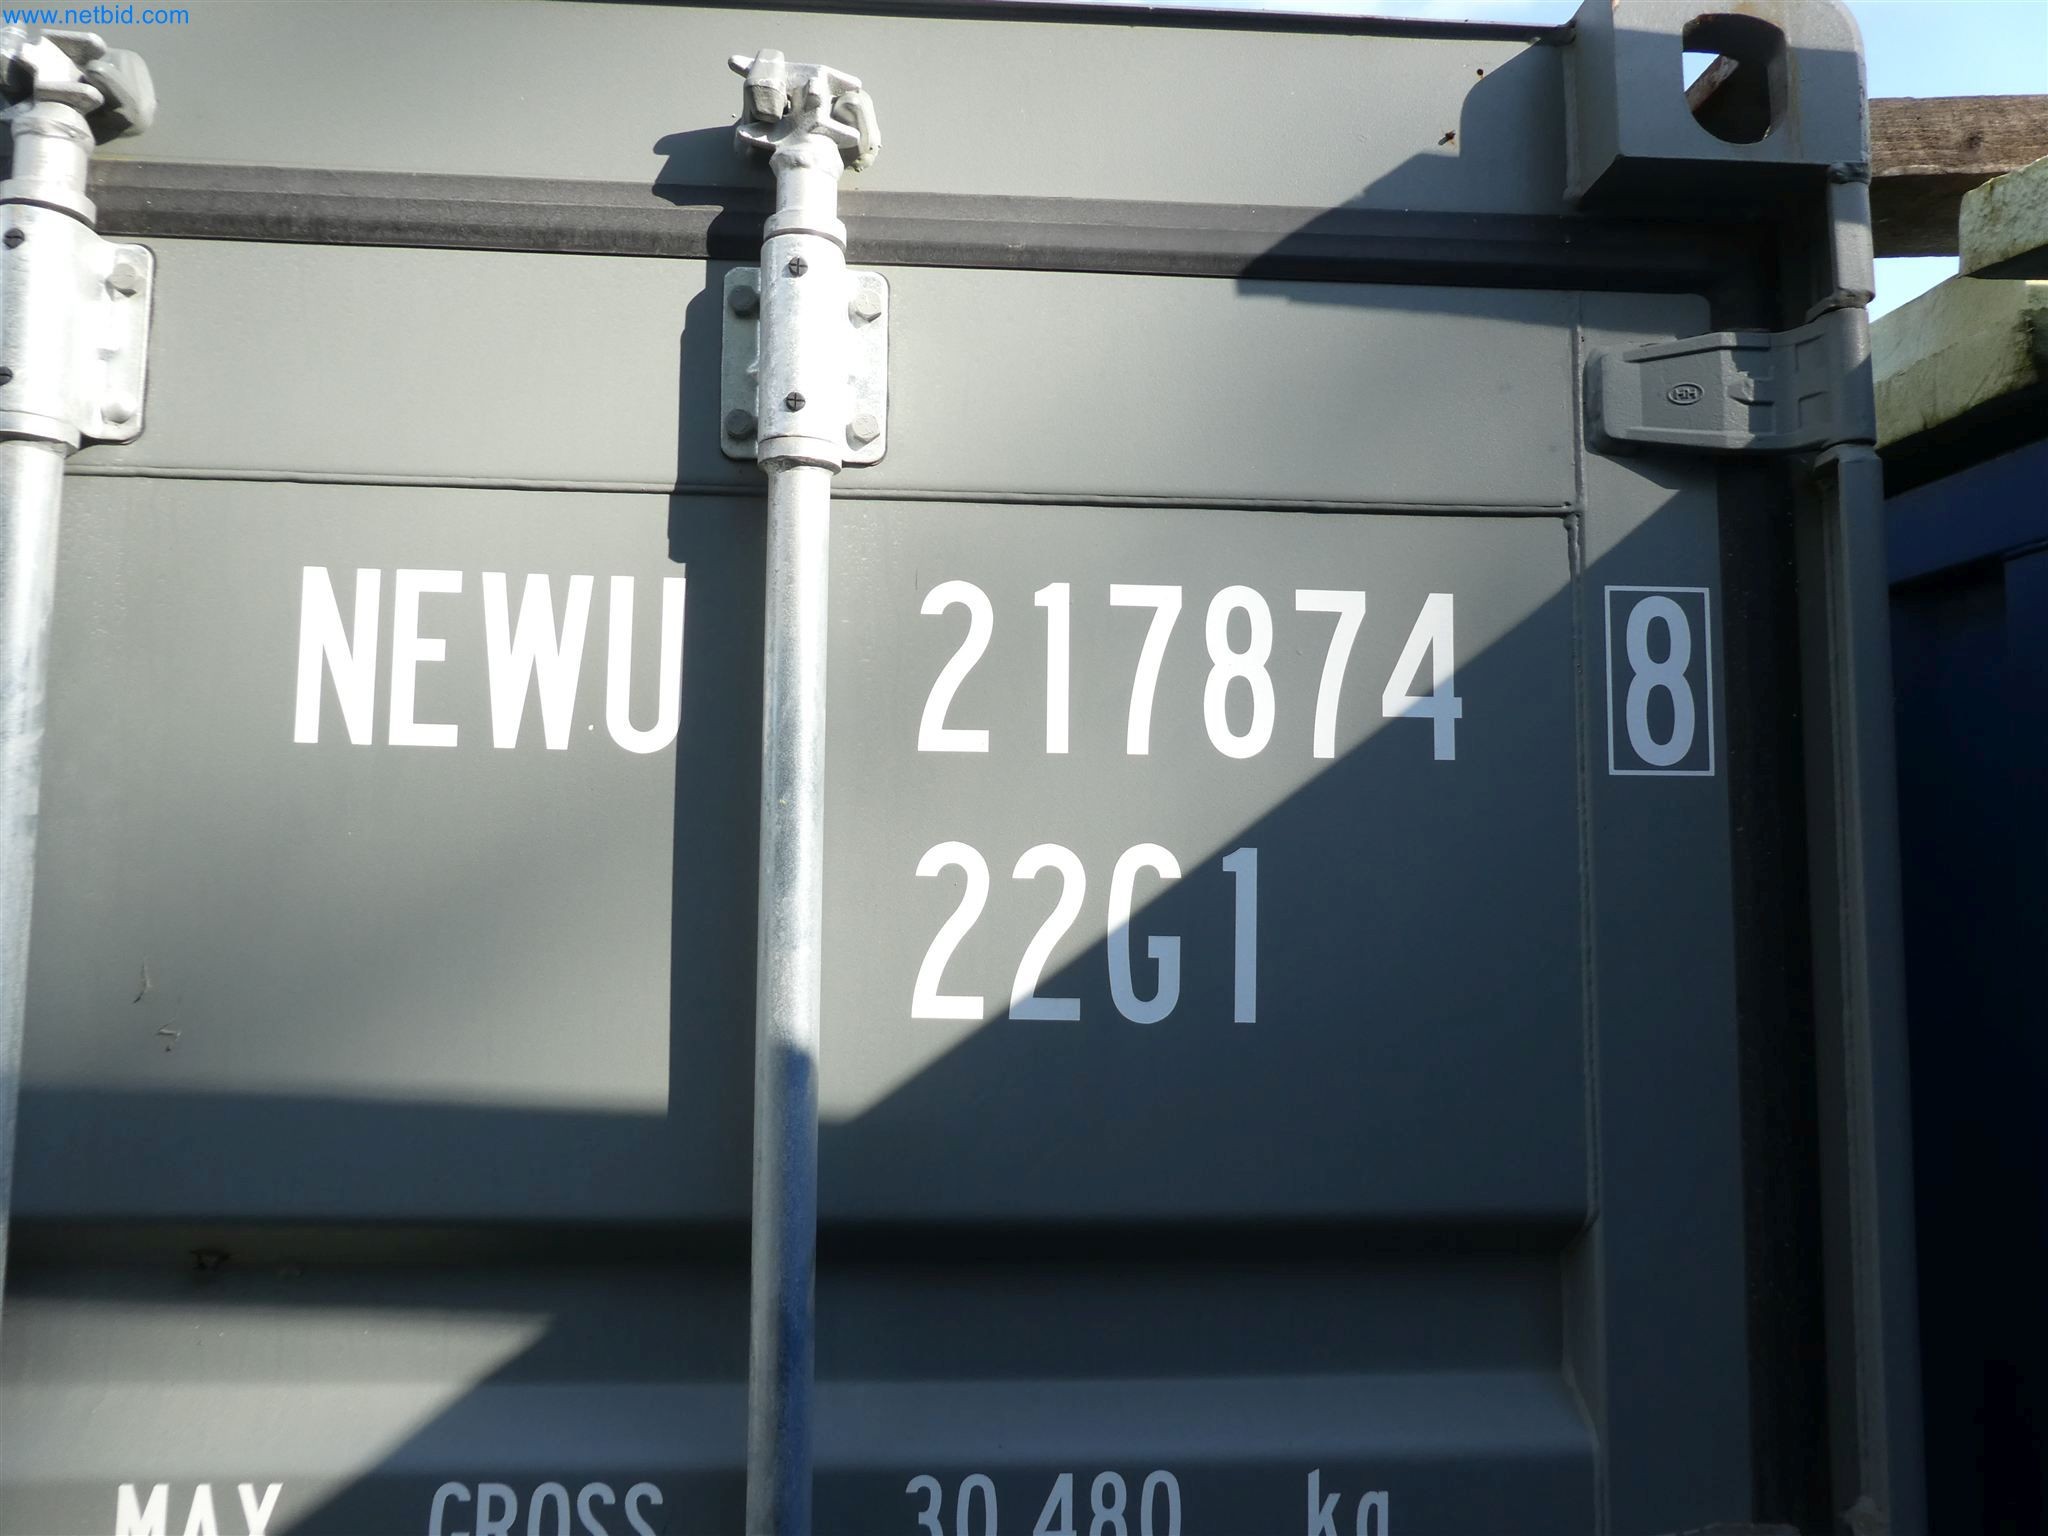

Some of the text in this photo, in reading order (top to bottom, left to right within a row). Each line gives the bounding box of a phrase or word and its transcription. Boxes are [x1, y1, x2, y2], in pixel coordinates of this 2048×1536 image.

[293, 566, 1696, 767] NEWU 217874 8
[911, 841, 1258, 1025] 22G1
